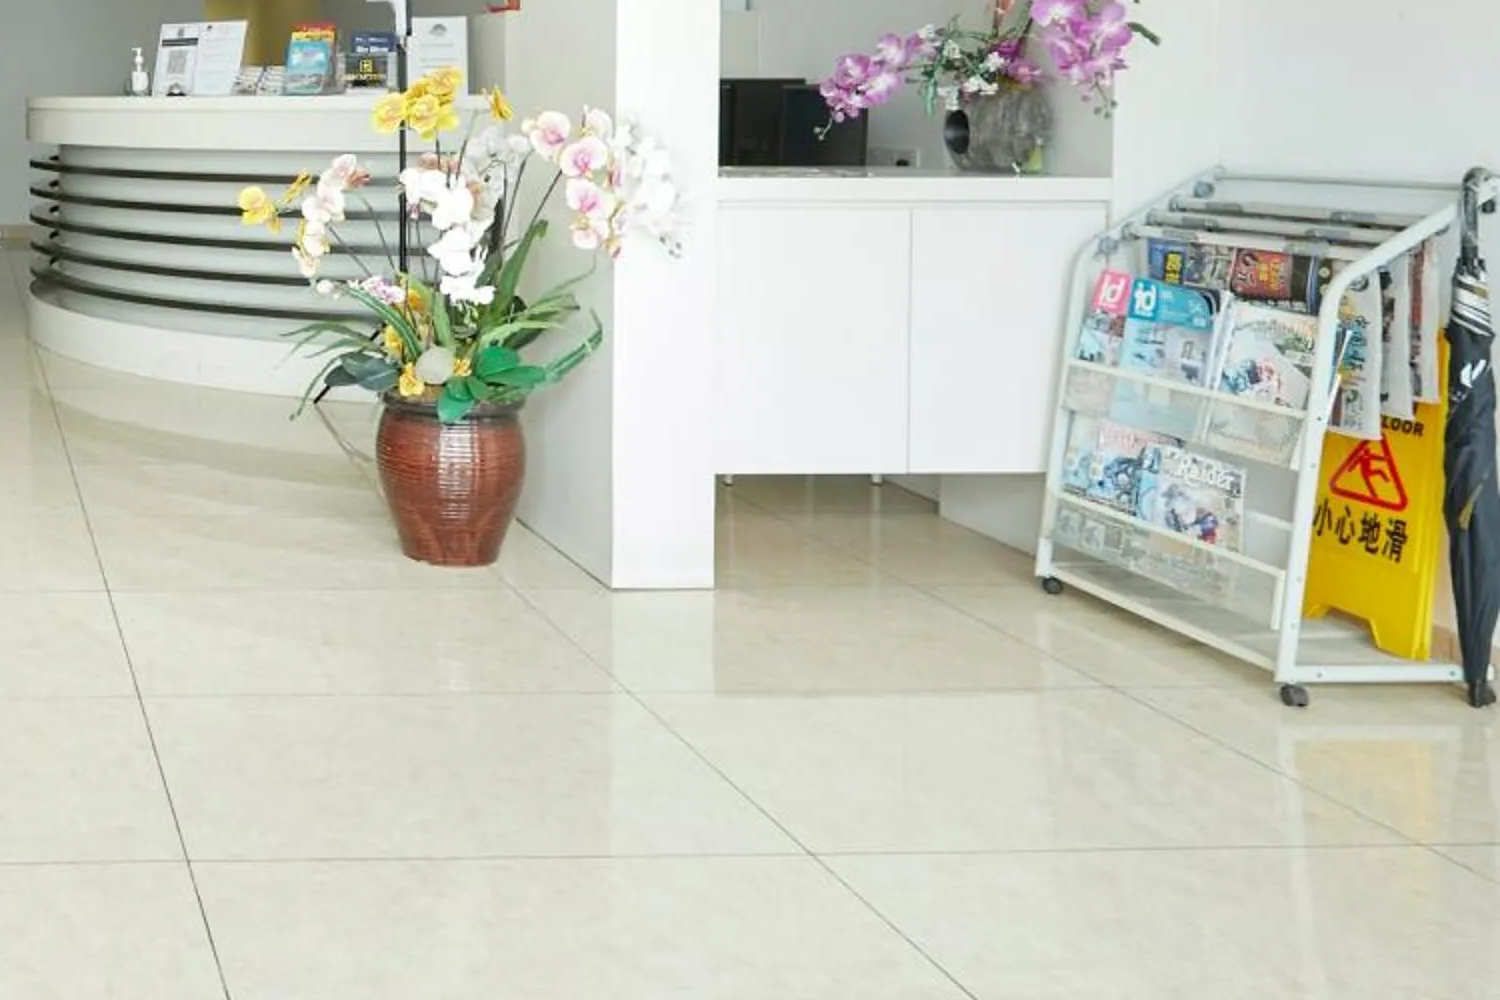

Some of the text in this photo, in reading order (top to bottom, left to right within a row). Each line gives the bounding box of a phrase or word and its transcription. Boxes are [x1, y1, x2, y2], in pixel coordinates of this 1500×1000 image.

[1380, 414, 1425, 437] LOOR
[1313, 498, 1408, 563] 小心地滑
